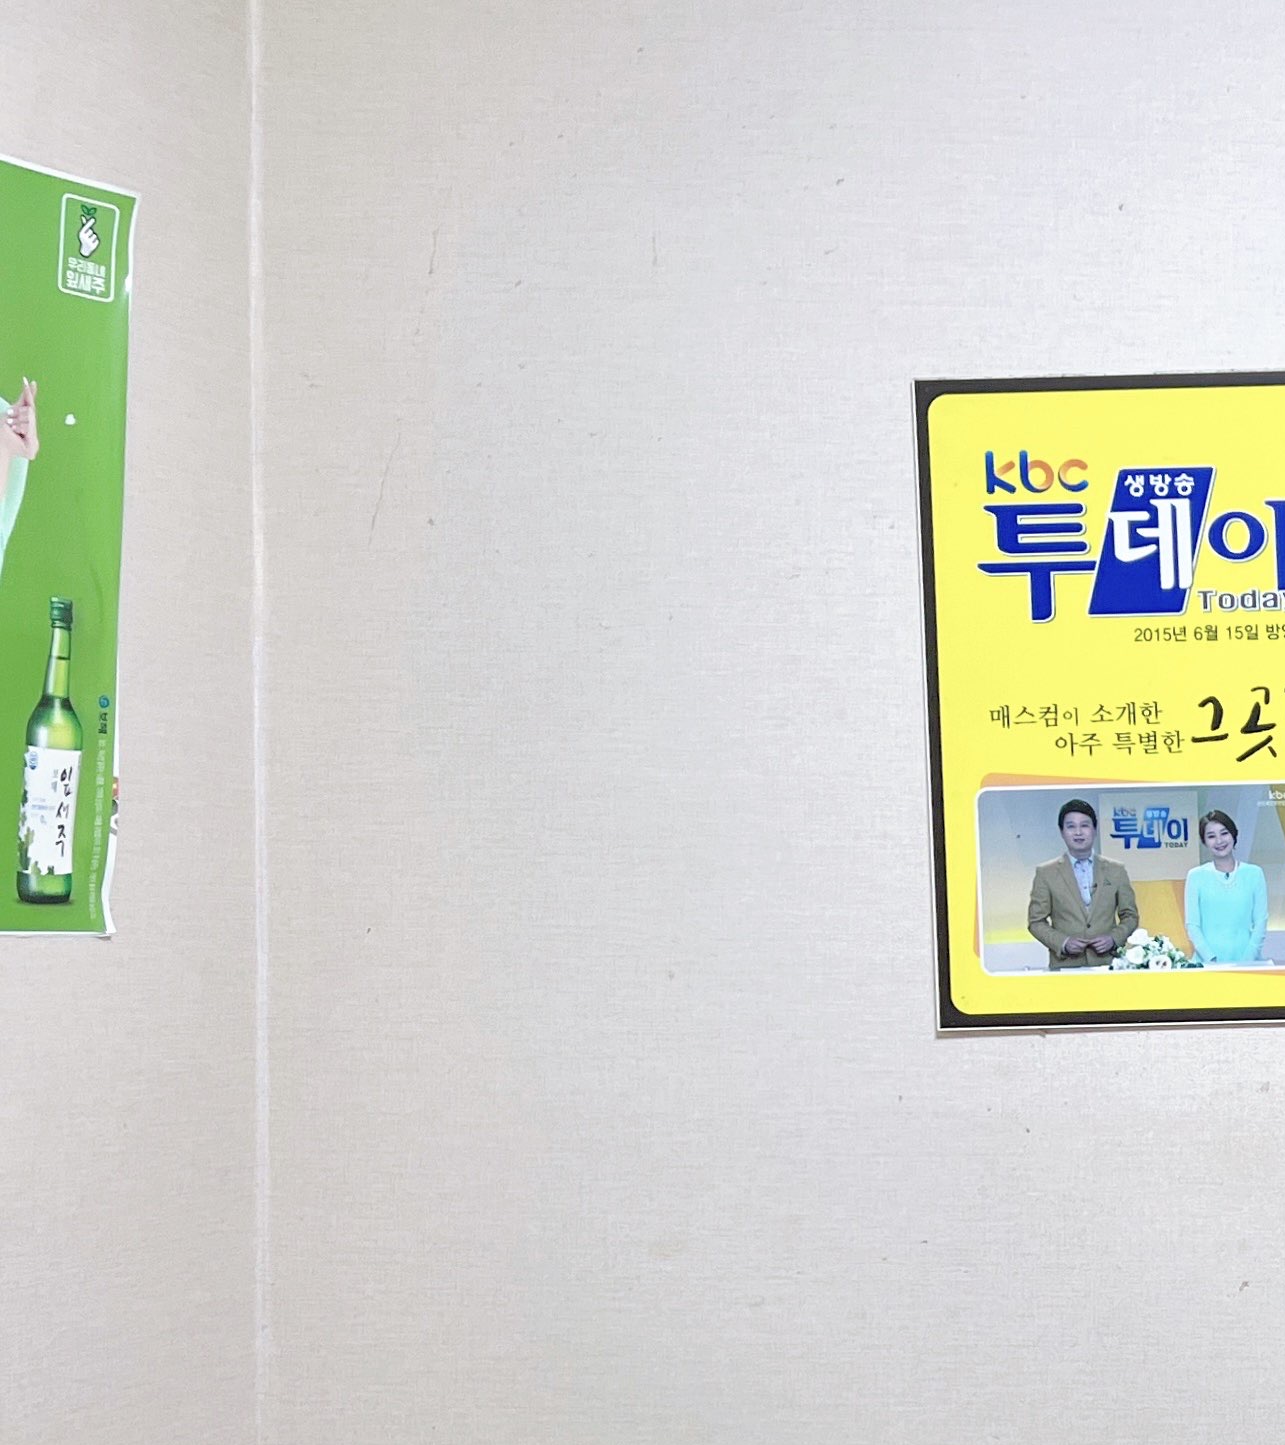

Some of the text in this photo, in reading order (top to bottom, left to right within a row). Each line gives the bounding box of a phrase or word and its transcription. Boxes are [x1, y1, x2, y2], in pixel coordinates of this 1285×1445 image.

[985, 450, 1089, 494] kbc
[1124, 474, 1195, 497] 생방송
[1134, 625, 1187, 642] 2015년
[1194, 624, 1219, 641] 6월
[1226, 623, 1259, 641] 15일
[990, 701, 1163, 729] 매스컴이 소개한
[1055, 730, 1186, 757] 아주 특별한
[1165, 841, 1189, 849] TODAY
